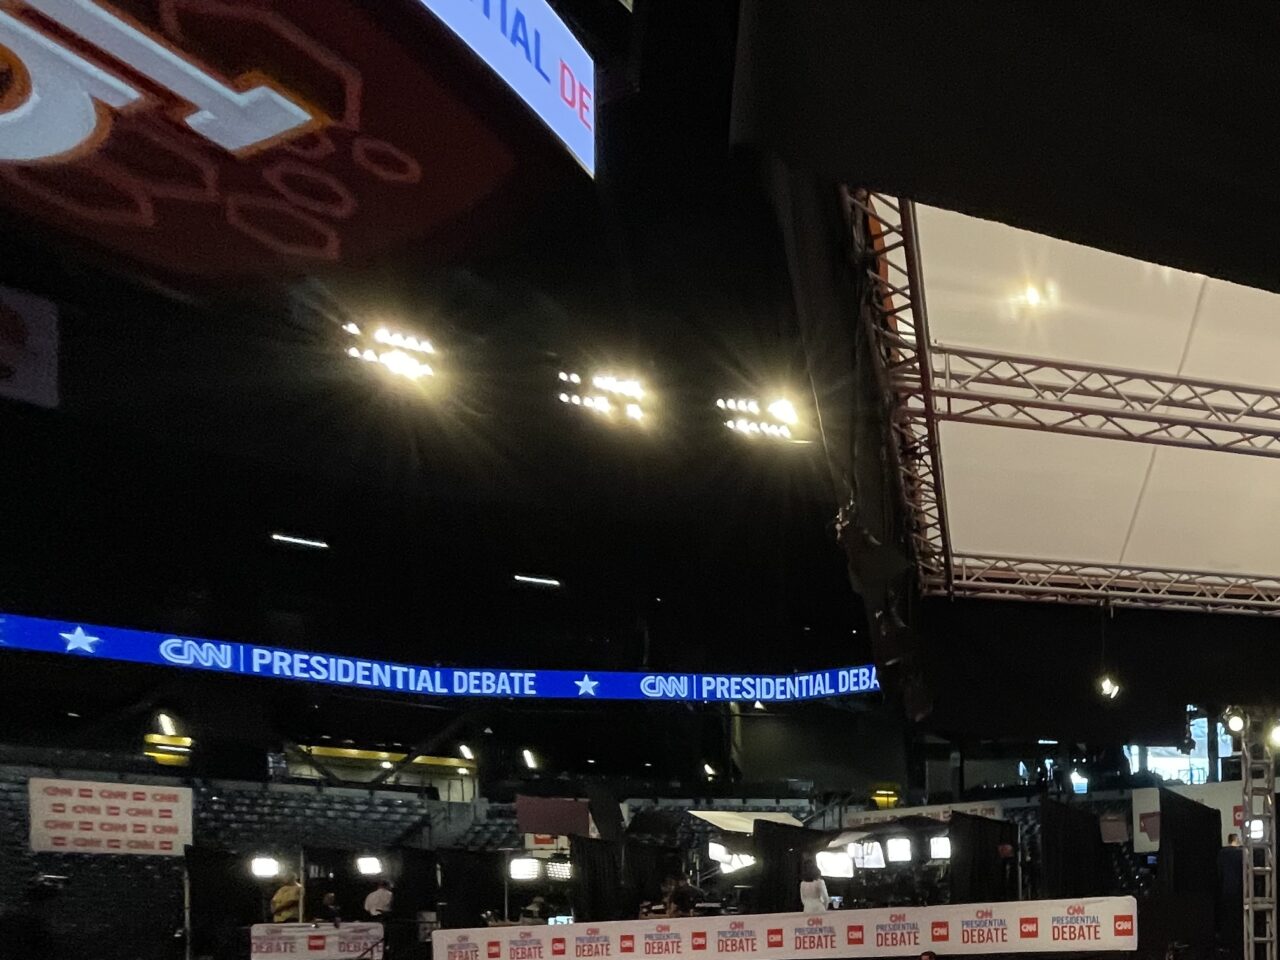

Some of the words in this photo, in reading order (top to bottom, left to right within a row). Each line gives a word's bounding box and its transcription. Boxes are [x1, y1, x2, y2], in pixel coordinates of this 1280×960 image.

[560, 58, 592, 132] DE
[159, 638, 232, 669] CNN
[252, 648, 448, 694] PRESIDENTIAL
[453, 671, 537, 695] DEBATE
[640, 675, 688, 698] CNN
[702, 675, 835, 699] PRESIDENTIAL
[962, 919, 1006, 928] PRESIDENTIAL
[1052, 916, 1100, 924] PRESIDENTIAL
[876, 932, 920, 947] DEBATE
[962, 928, 1008, 944] DEBATE
[1052, 924, 1101, 941] DEBATE
[644, 941, 682, 954] DEBATE
[718, 938, 757, 952] DEBATE
[794, 935, 836, 950] DEBATE
[510, 946, 544, 960] DEBATE
[576, 944, 611, 957] DEBATE
